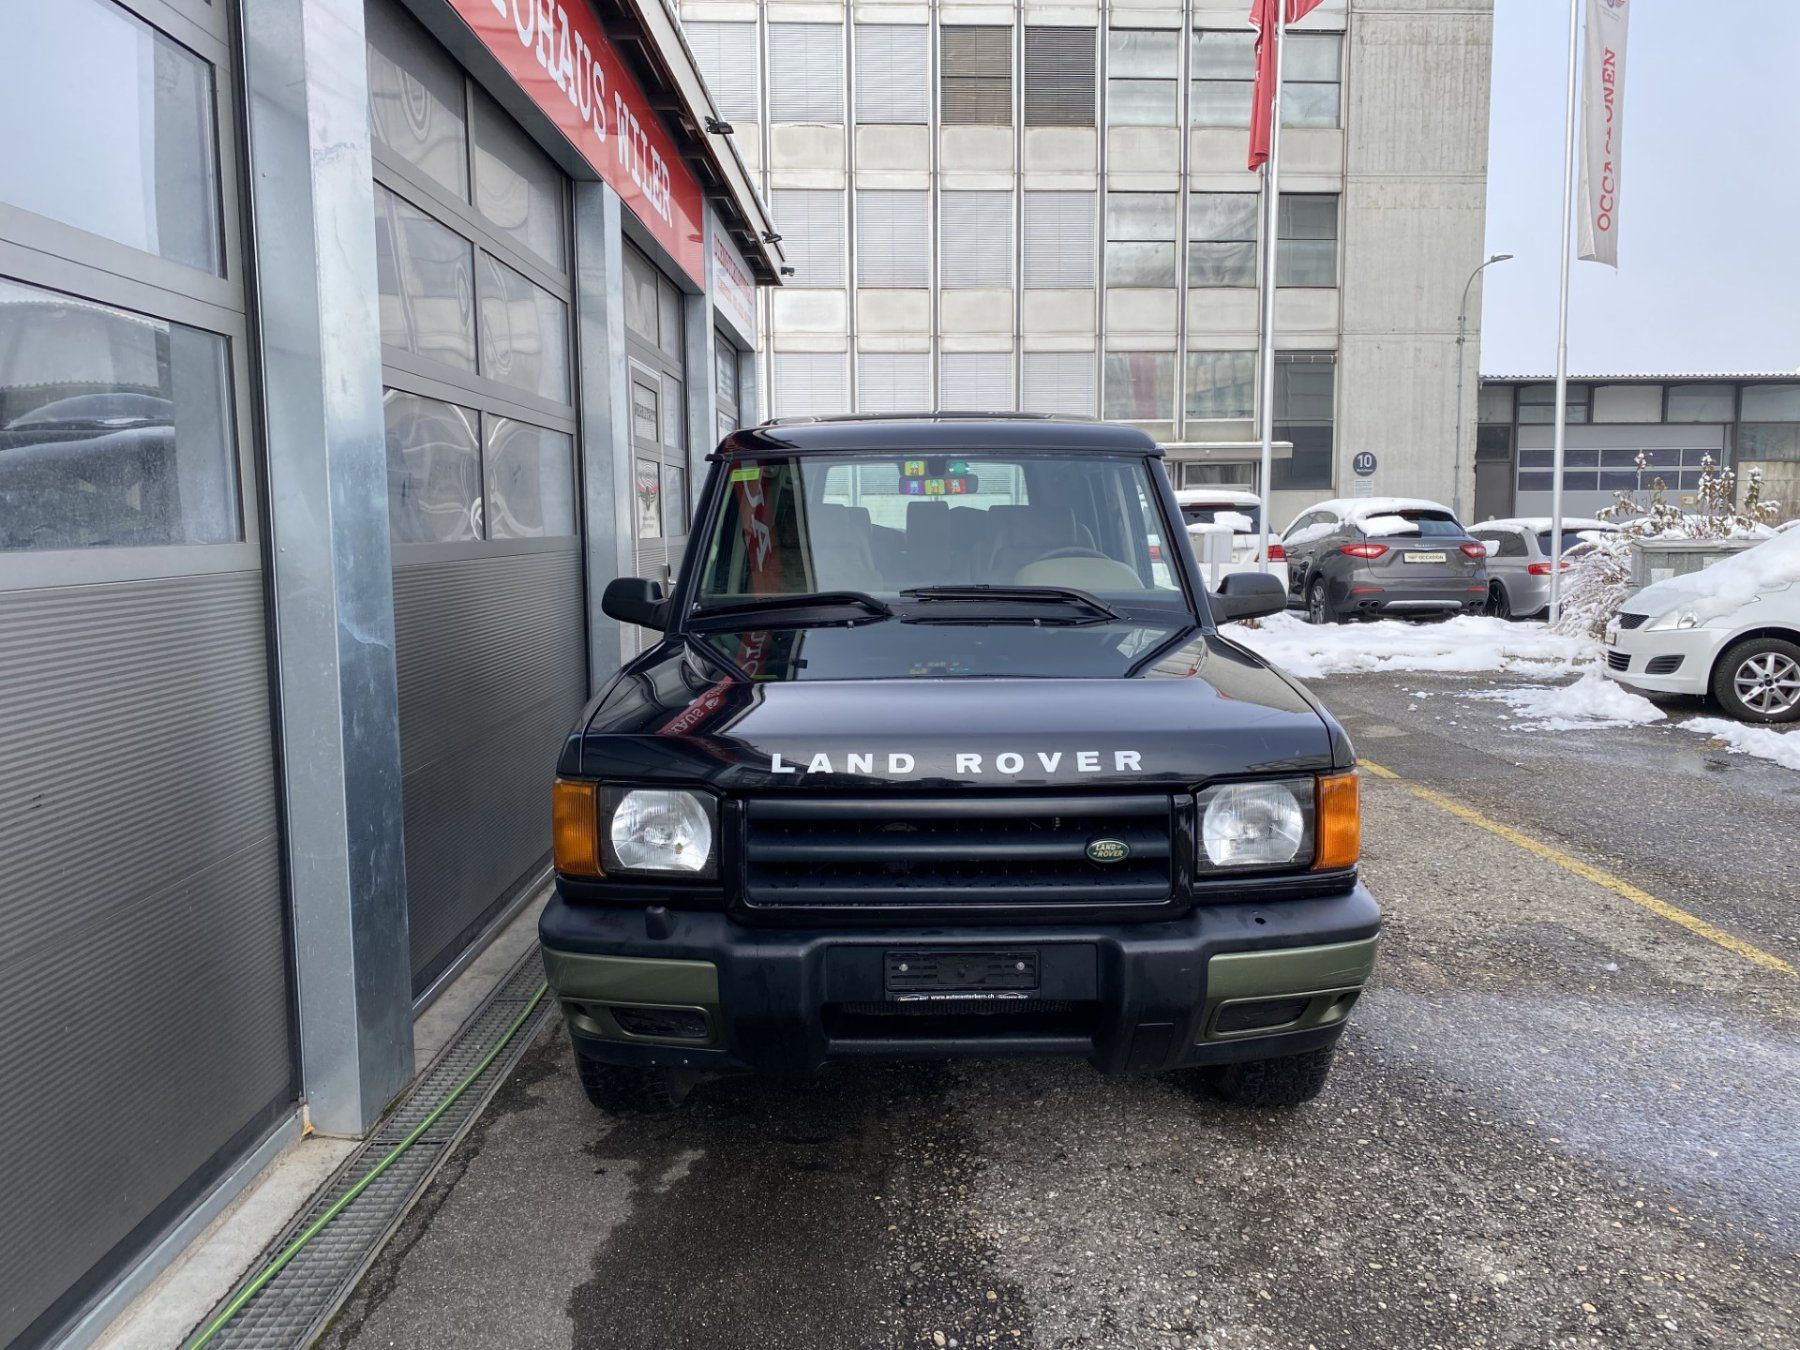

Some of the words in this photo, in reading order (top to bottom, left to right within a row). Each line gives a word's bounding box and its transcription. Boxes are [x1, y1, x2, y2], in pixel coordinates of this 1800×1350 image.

[491, 0, 606, 142] OHAUS
[614, 90, 673, 228] WILER
[1357, 454, 1372, 467] 10
[770, 753, 915, 774] LAND
[955, 750, 1143, 774] ROVER
